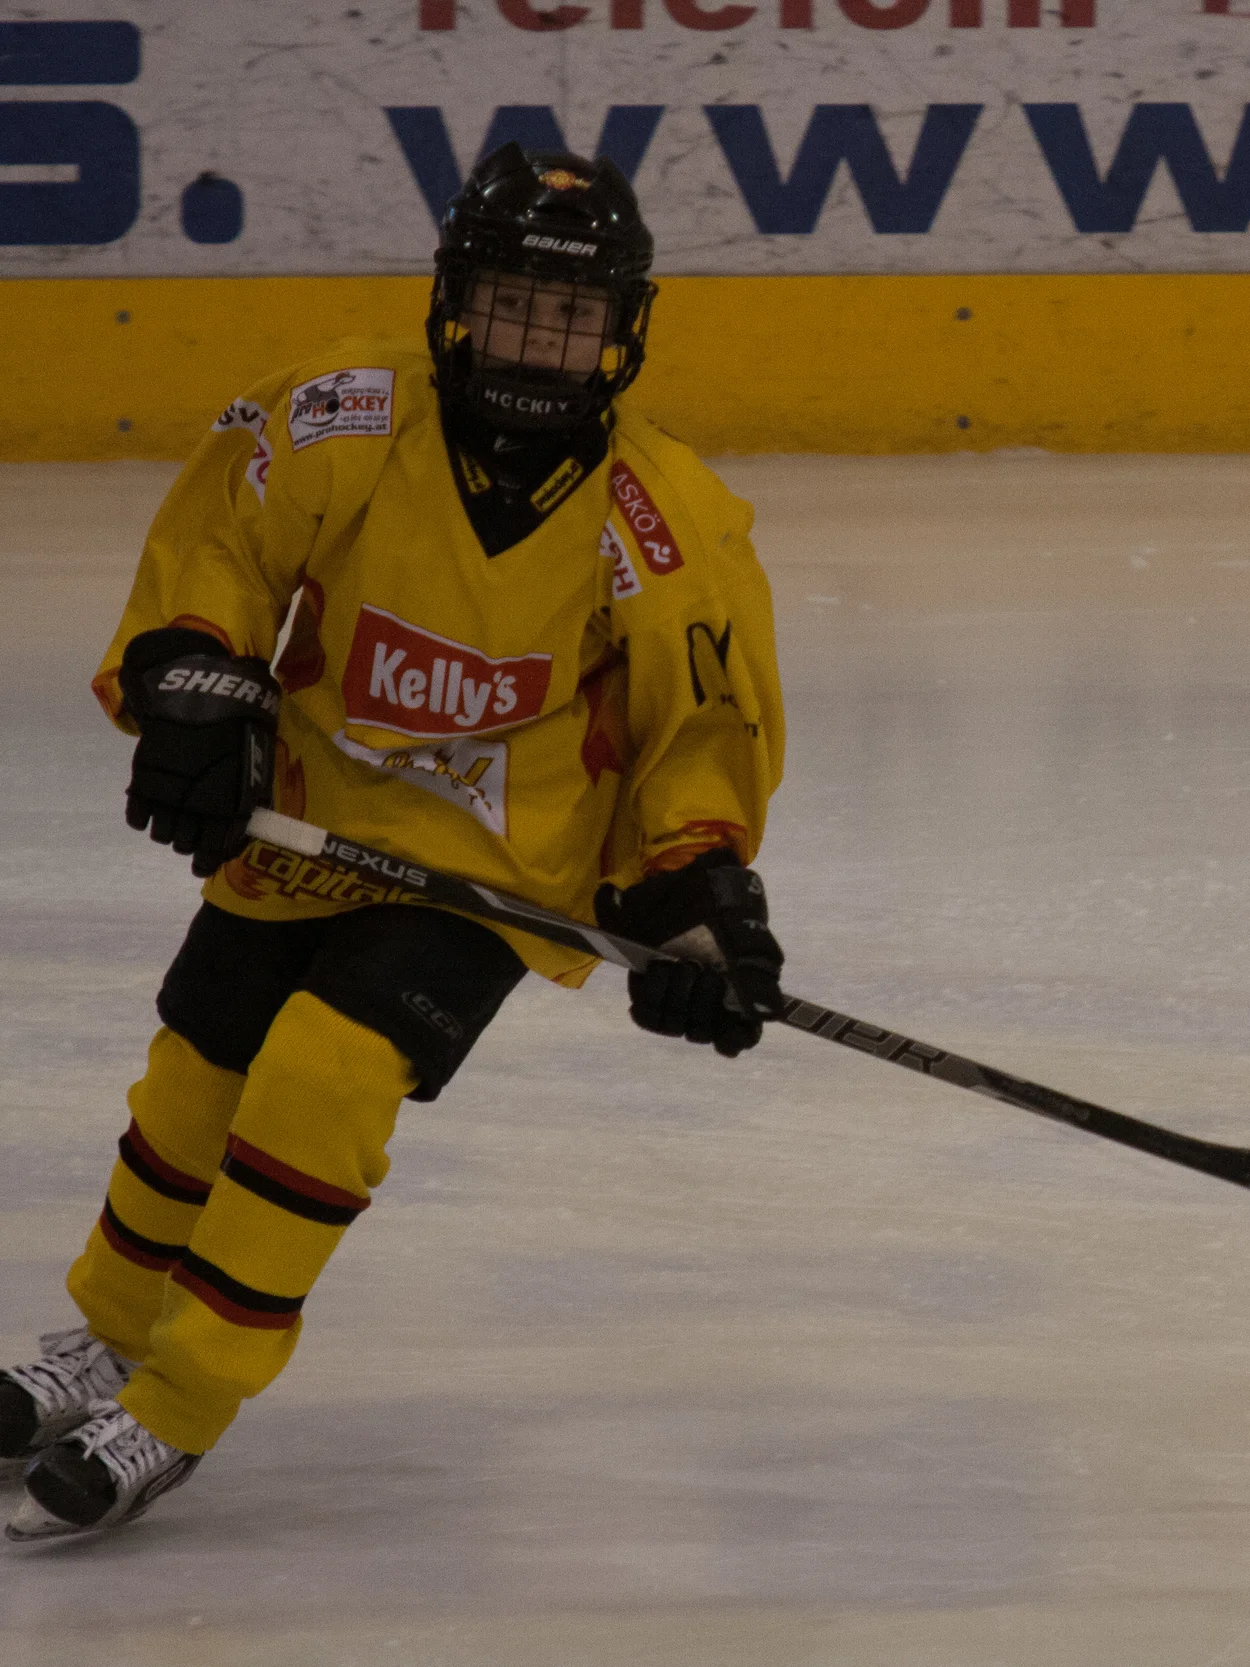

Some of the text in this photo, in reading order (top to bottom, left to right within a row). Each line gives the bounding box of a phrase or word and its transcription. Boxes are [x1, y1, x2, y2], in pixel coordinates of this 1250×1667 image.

[521, 233, 598, 257] BAUER
[611, 472, 661, 533] ASKÖ
[369, 641, 518, 728] Kelly's
[322, 841, 428, 888] NEXUS
